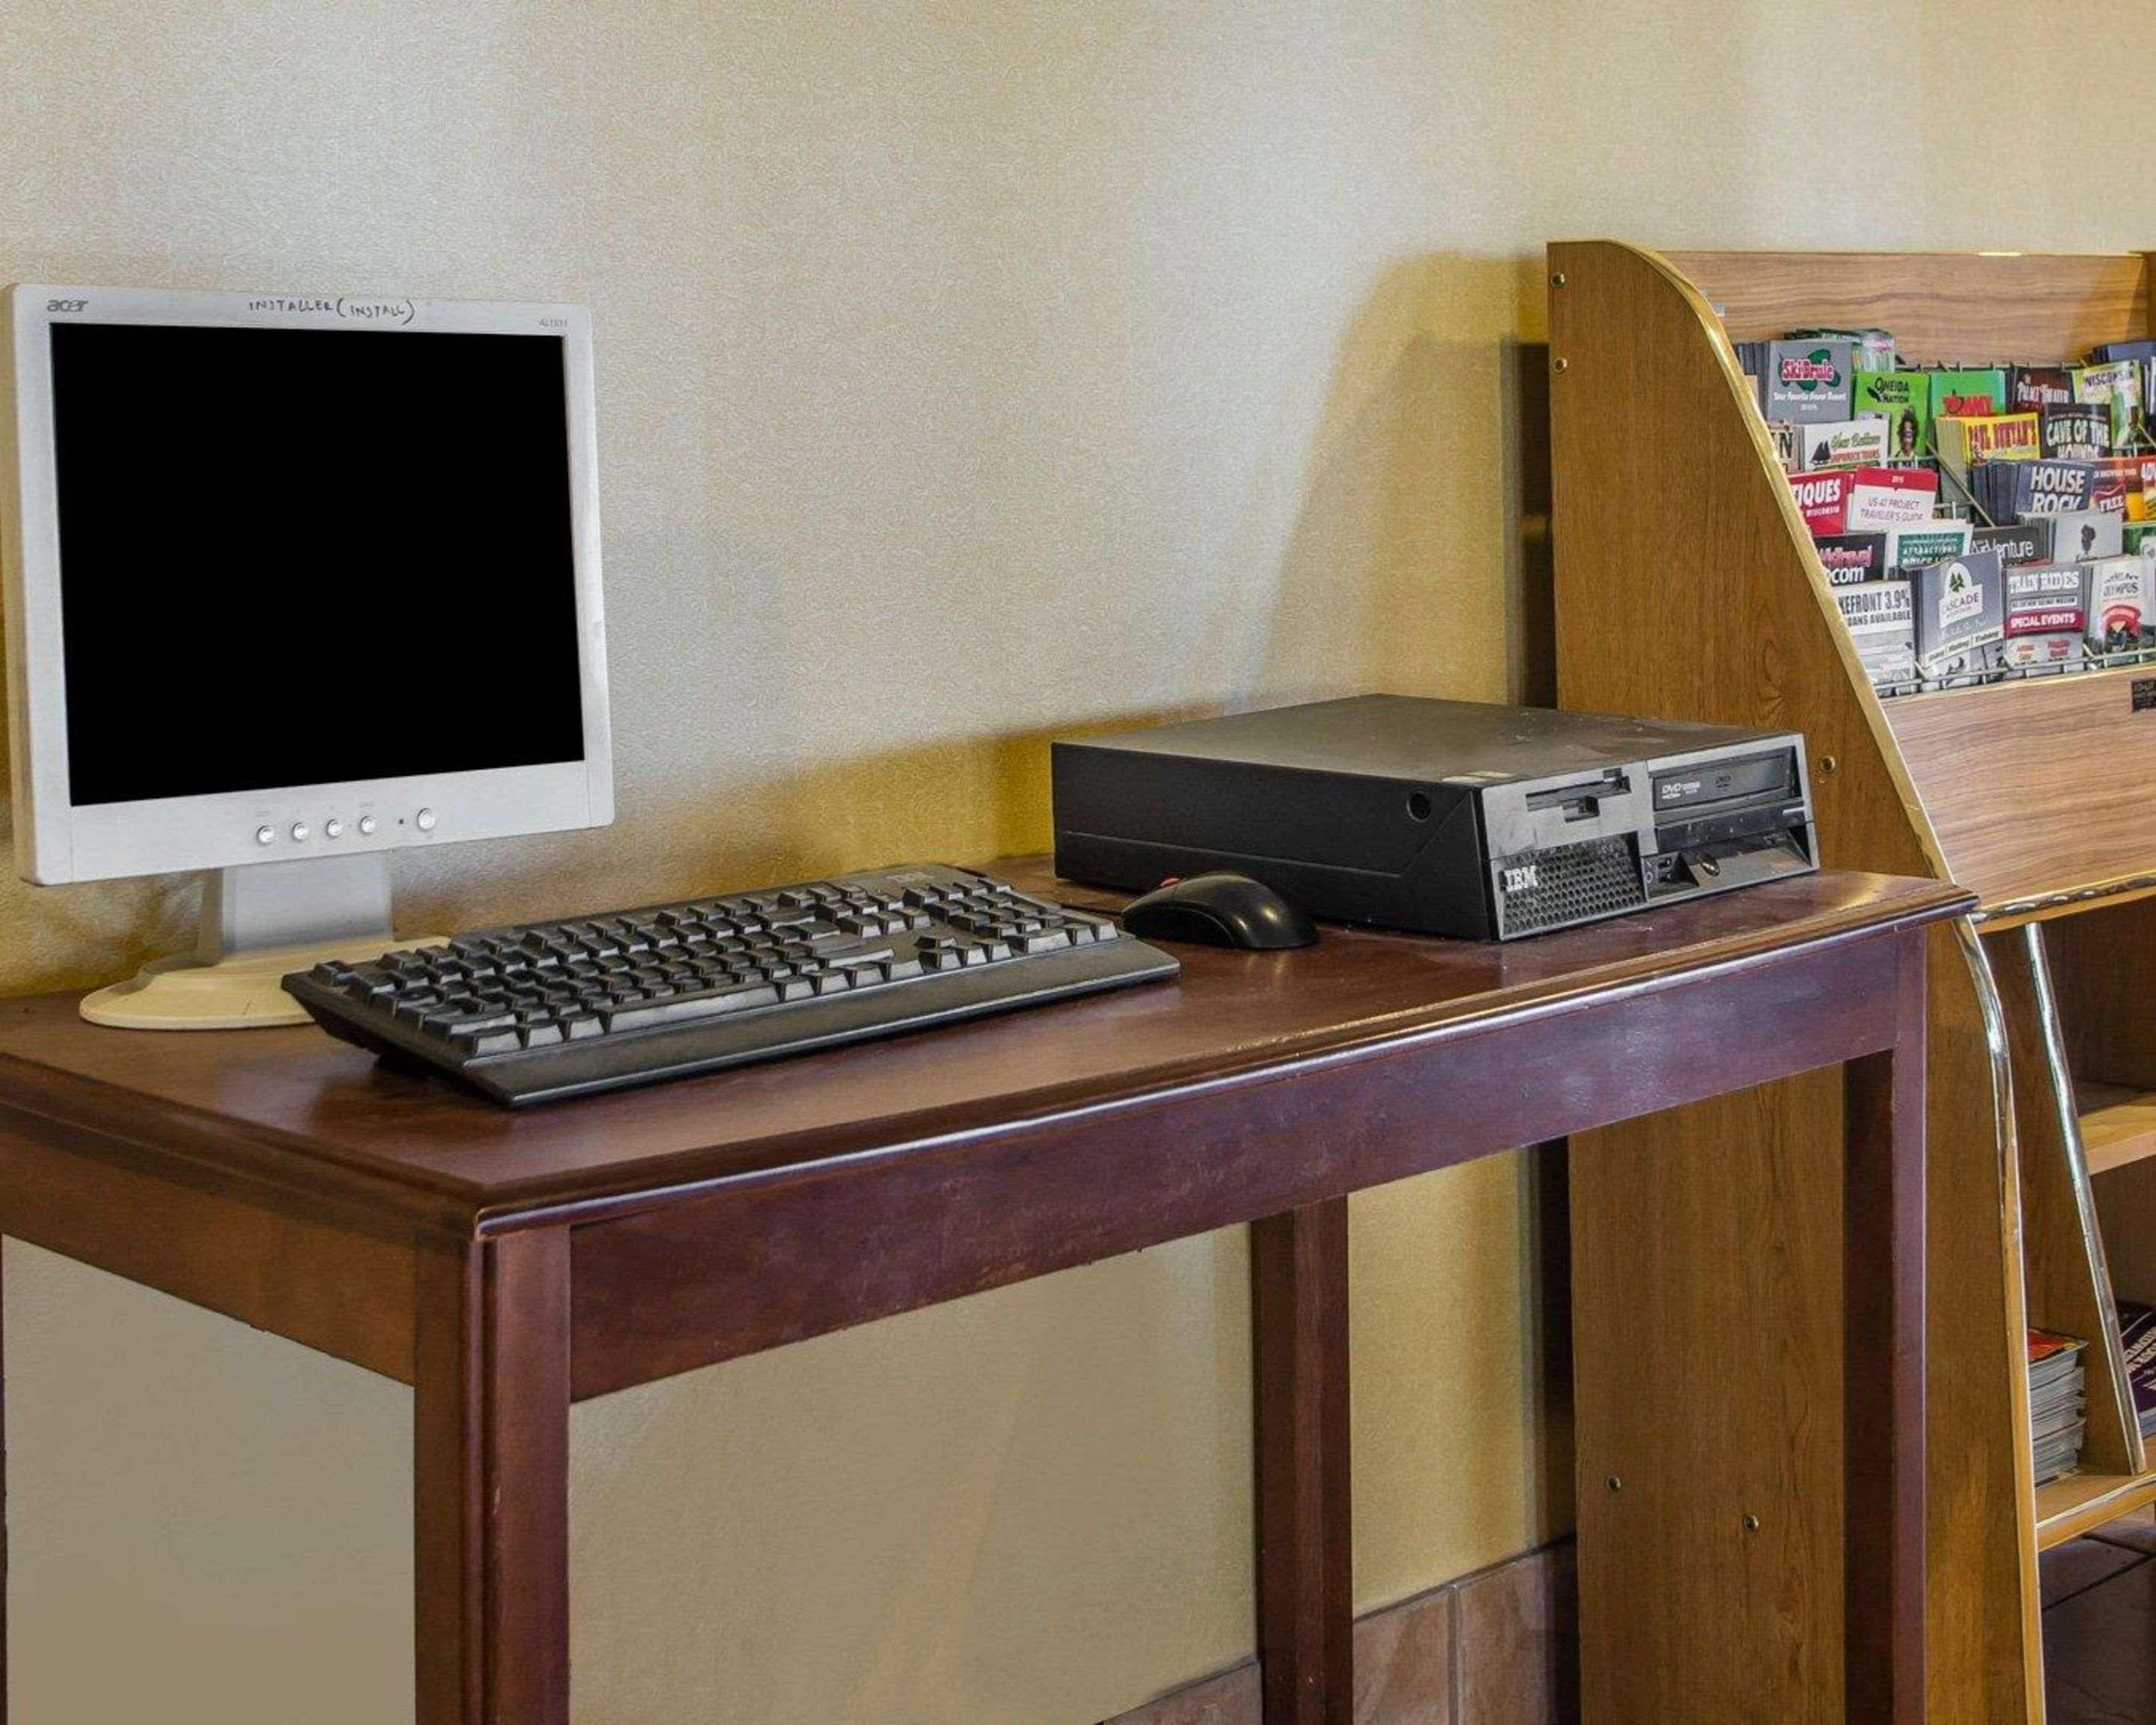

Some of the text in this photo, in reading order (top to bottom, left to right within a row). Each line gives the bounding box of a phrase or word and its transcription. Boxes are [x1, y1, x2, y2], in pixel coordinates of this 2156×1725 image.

[47, 299, 88, 312] acer
[1875, 377, 1909, 393] ONEIDA
[2046, 419, 2110, 448] CAVE OF THE
[2030, 466, 2086, 494] HOUSE
[2032, 492, 2083, 514] ROCK
[2099, 494, 2123, 512] FREE
[1870, 610, 1910, 624] AVAILABLE
[2010, 613, 2076, 629] SPECIAL EVENTS
[1504, 865, 1538, 892] IBM
